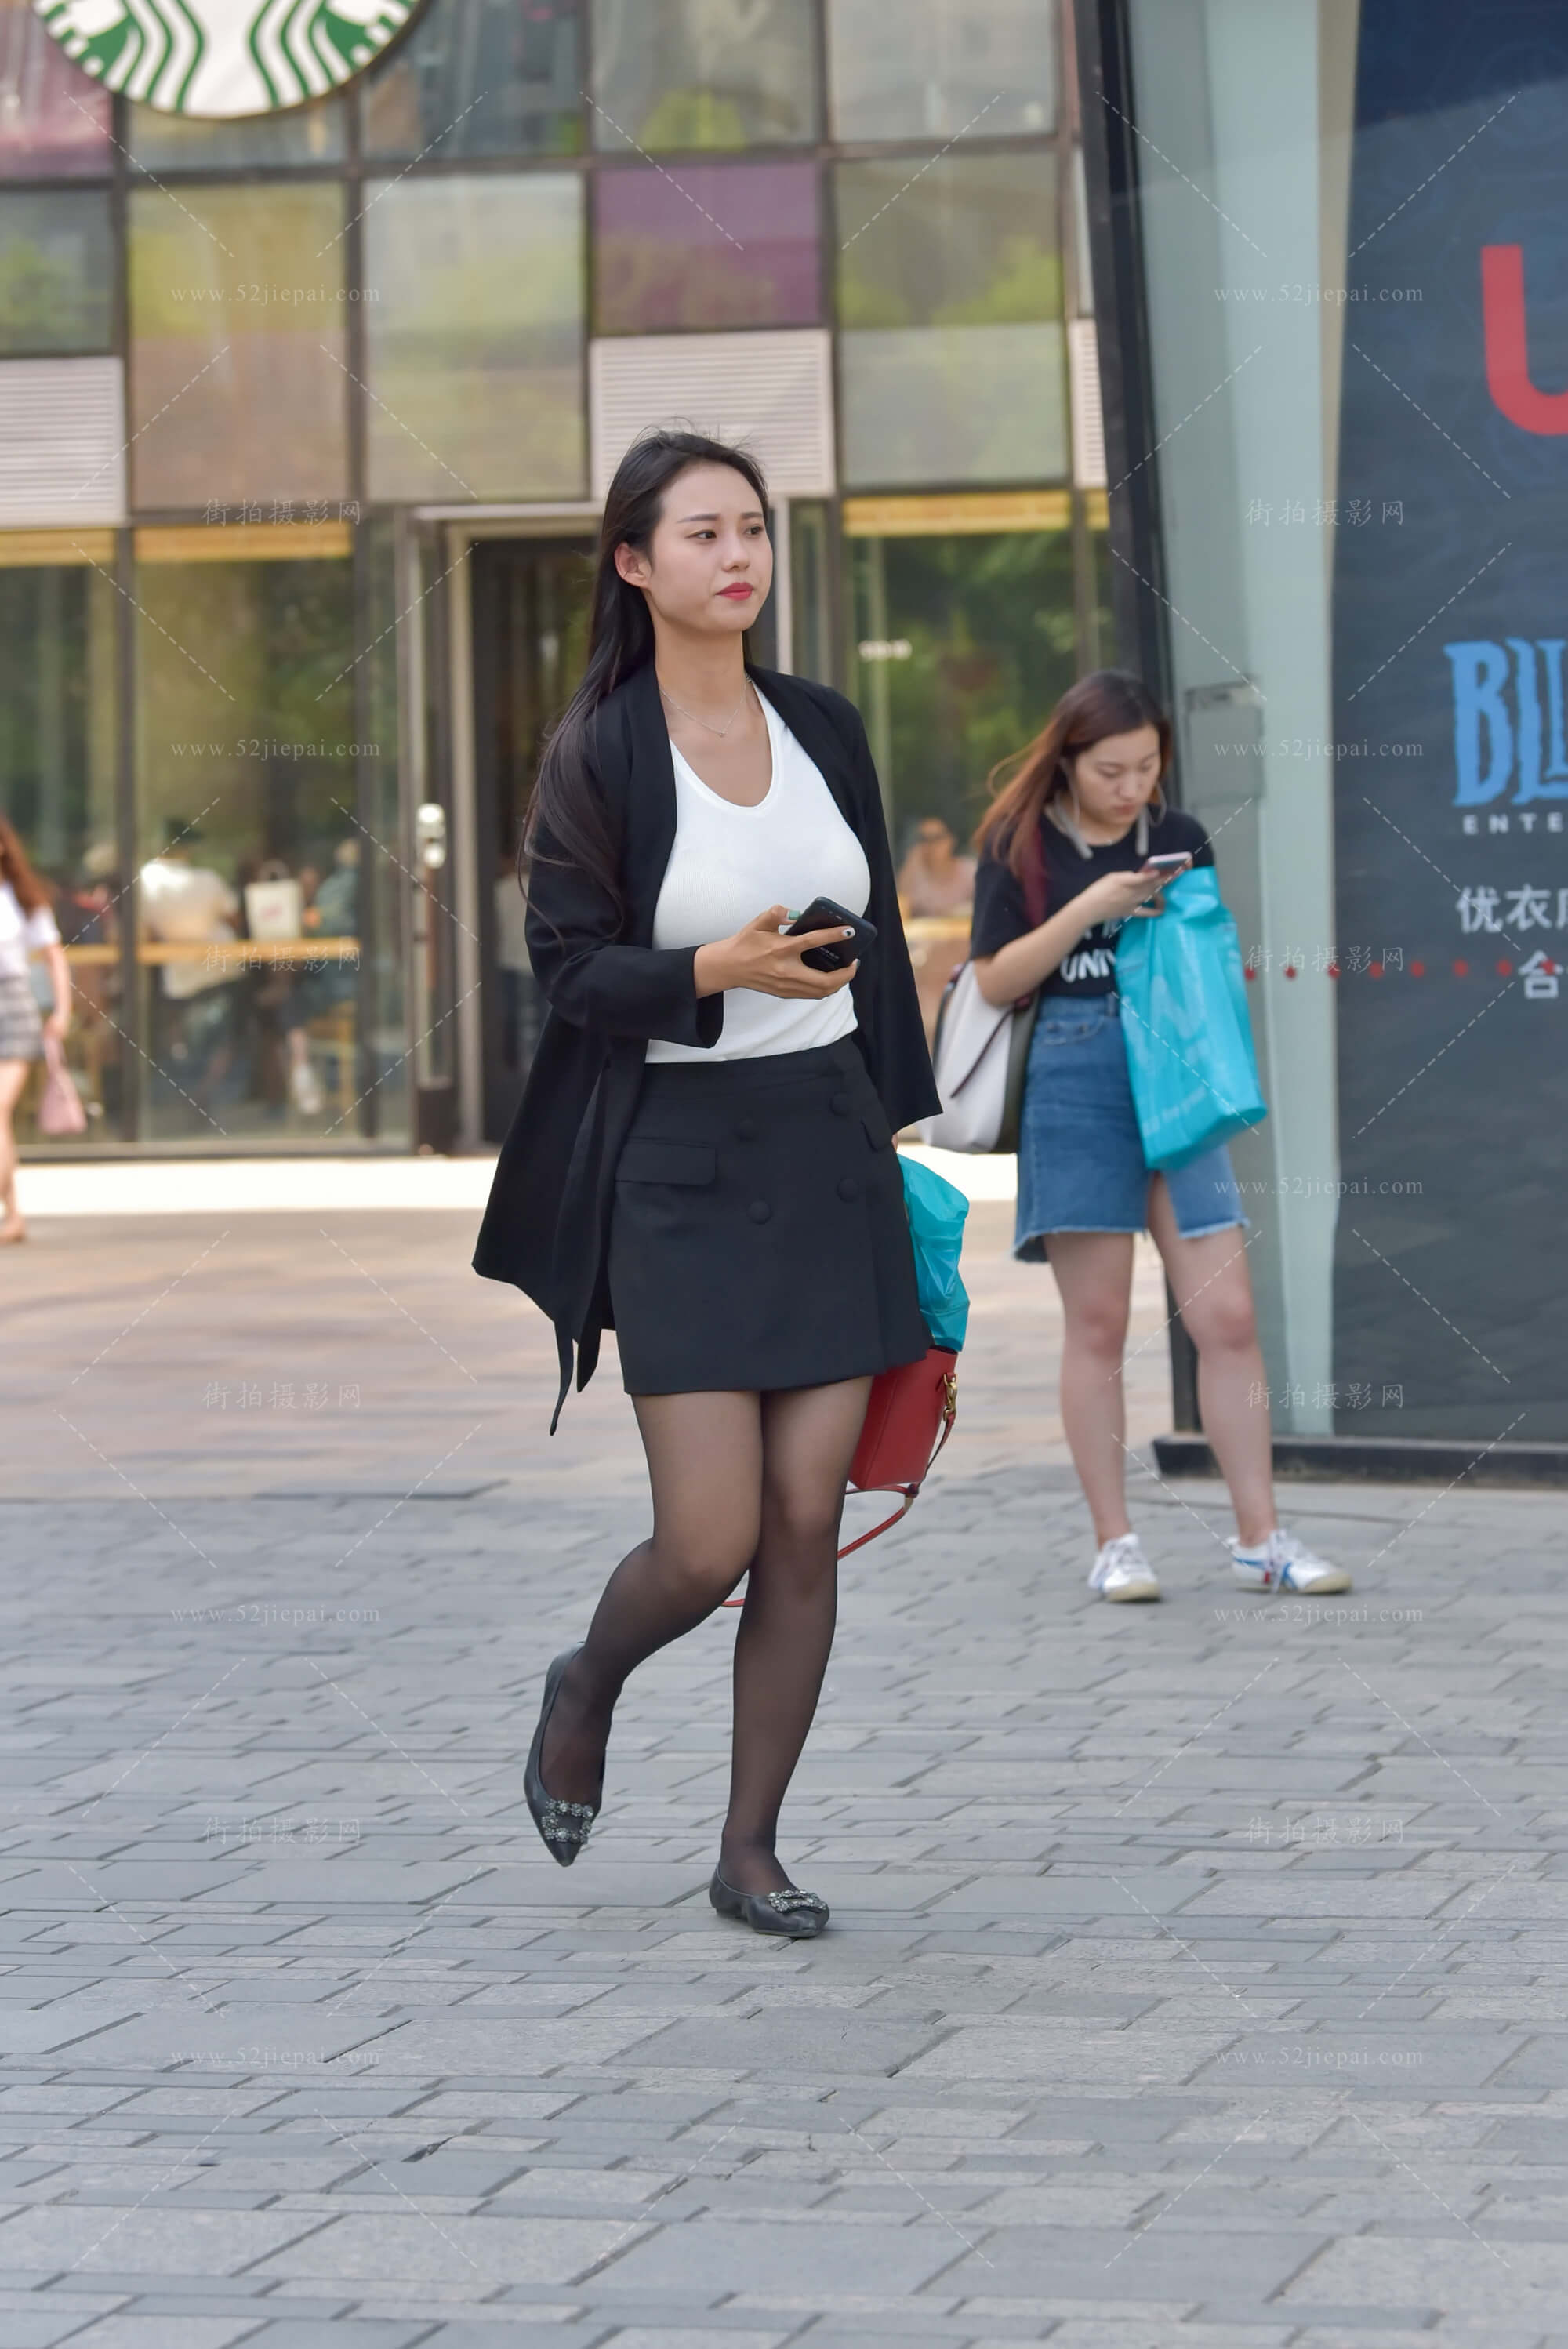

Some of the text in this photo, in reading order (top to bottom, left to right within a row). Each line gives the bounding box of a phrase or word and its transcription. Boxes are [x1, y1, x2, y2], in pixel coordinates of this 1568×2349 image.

[1462, 813, 1563, 835] ENTE
[1456, 883, 1568, 933] 优衣
[1519, 951, 1568, 998] 合
